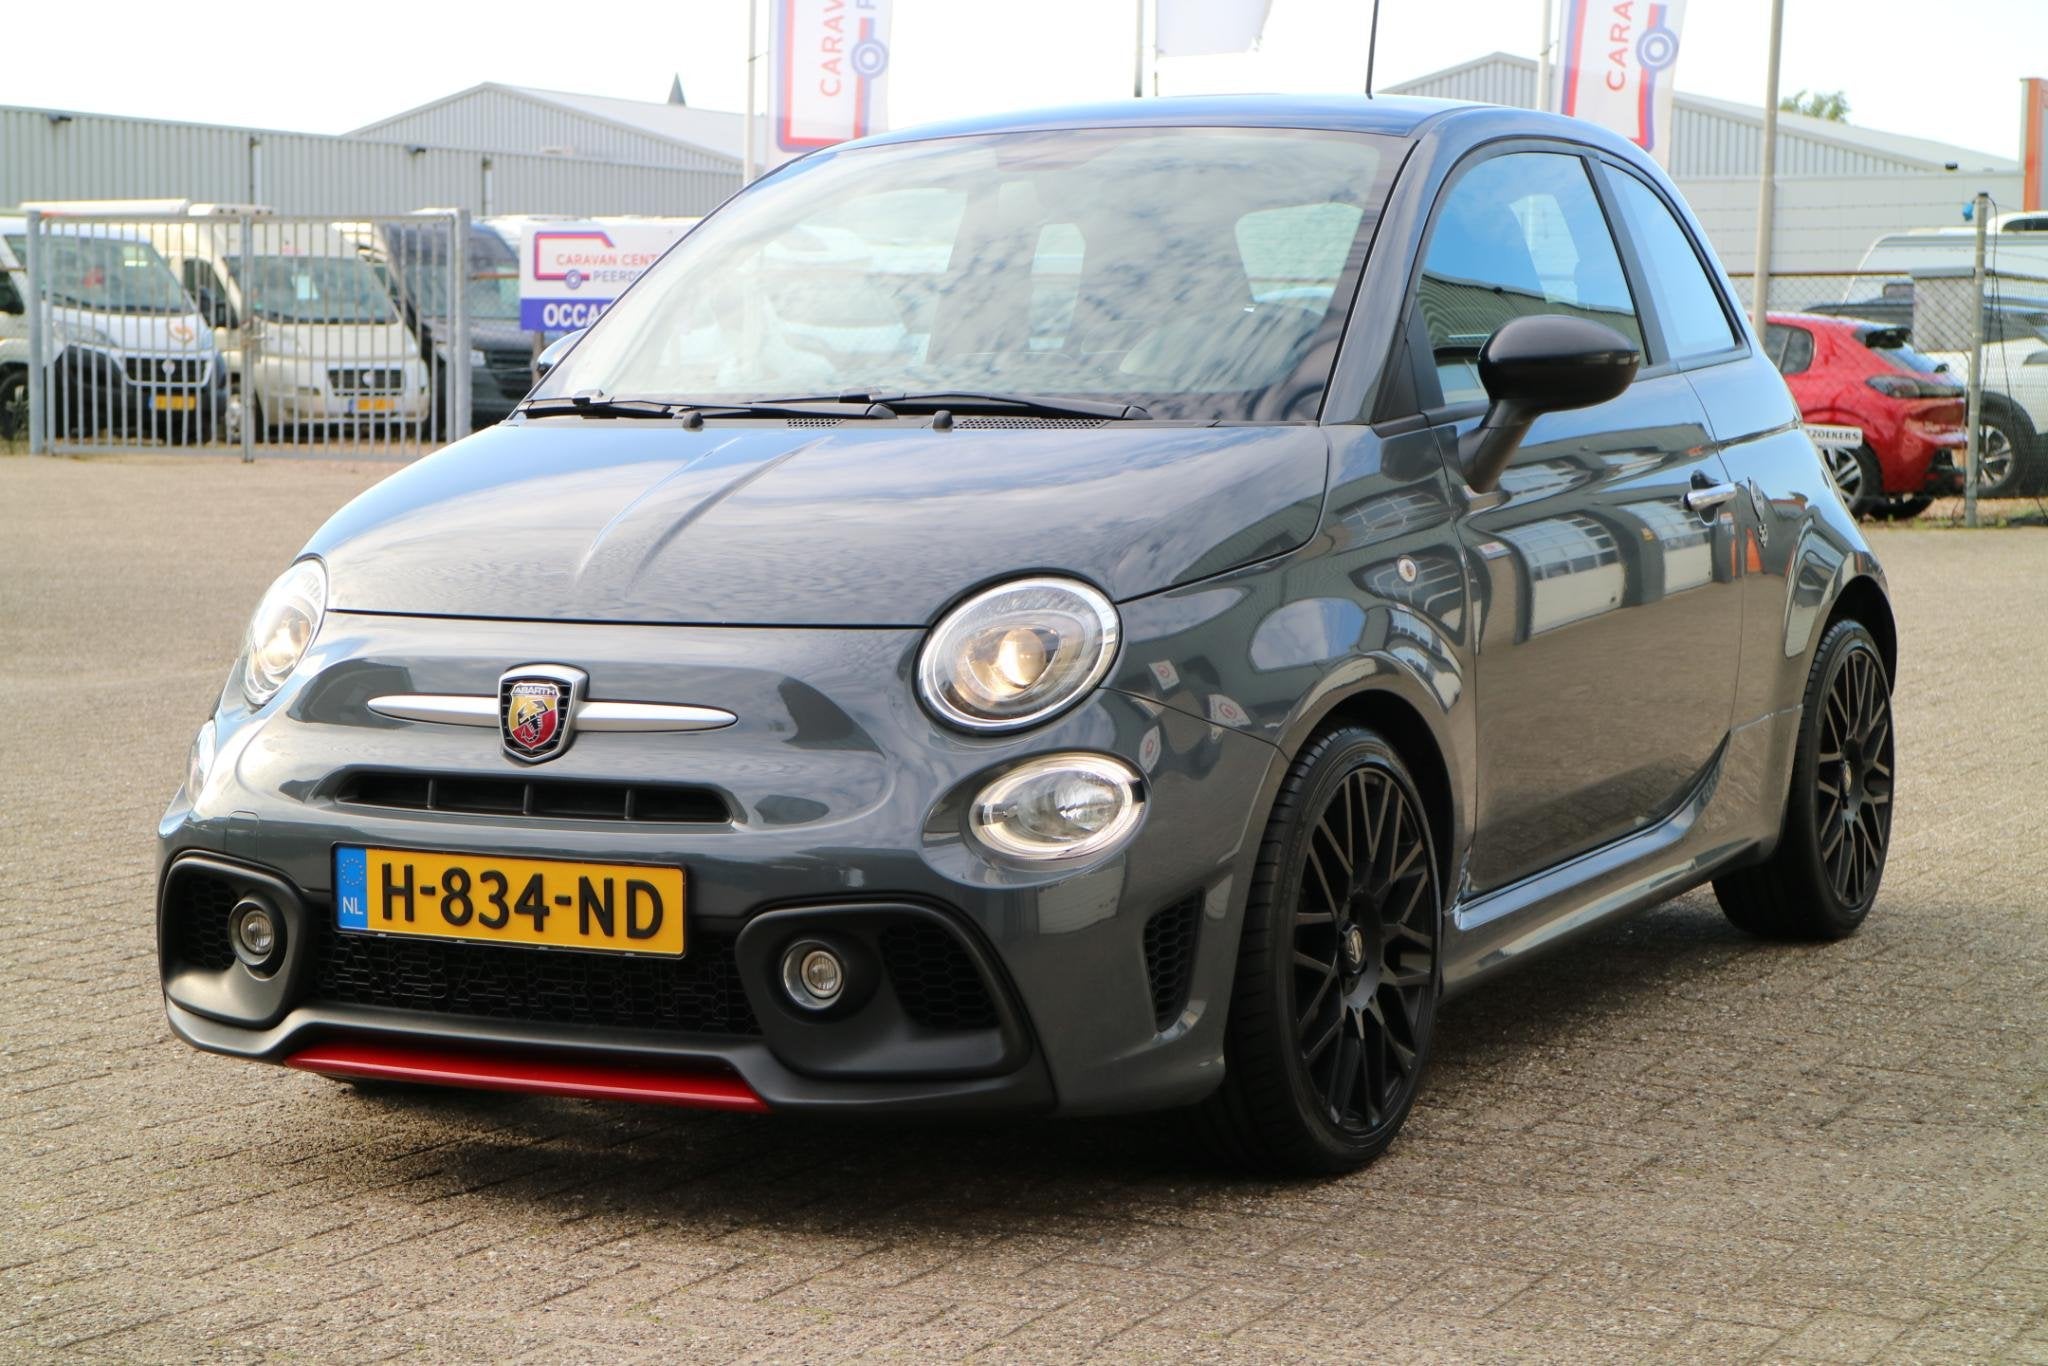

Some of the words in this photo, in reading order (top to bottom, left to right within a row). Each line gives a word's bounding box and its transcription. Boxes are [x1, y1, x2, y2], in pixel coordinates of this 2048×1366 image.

[556, 253, 617, 266] CARAVAN
[514, 685, 556, 696] ABARTH
[342, 896, 364, 916] NL
[381, 862, 664, 940] H-834-ND
